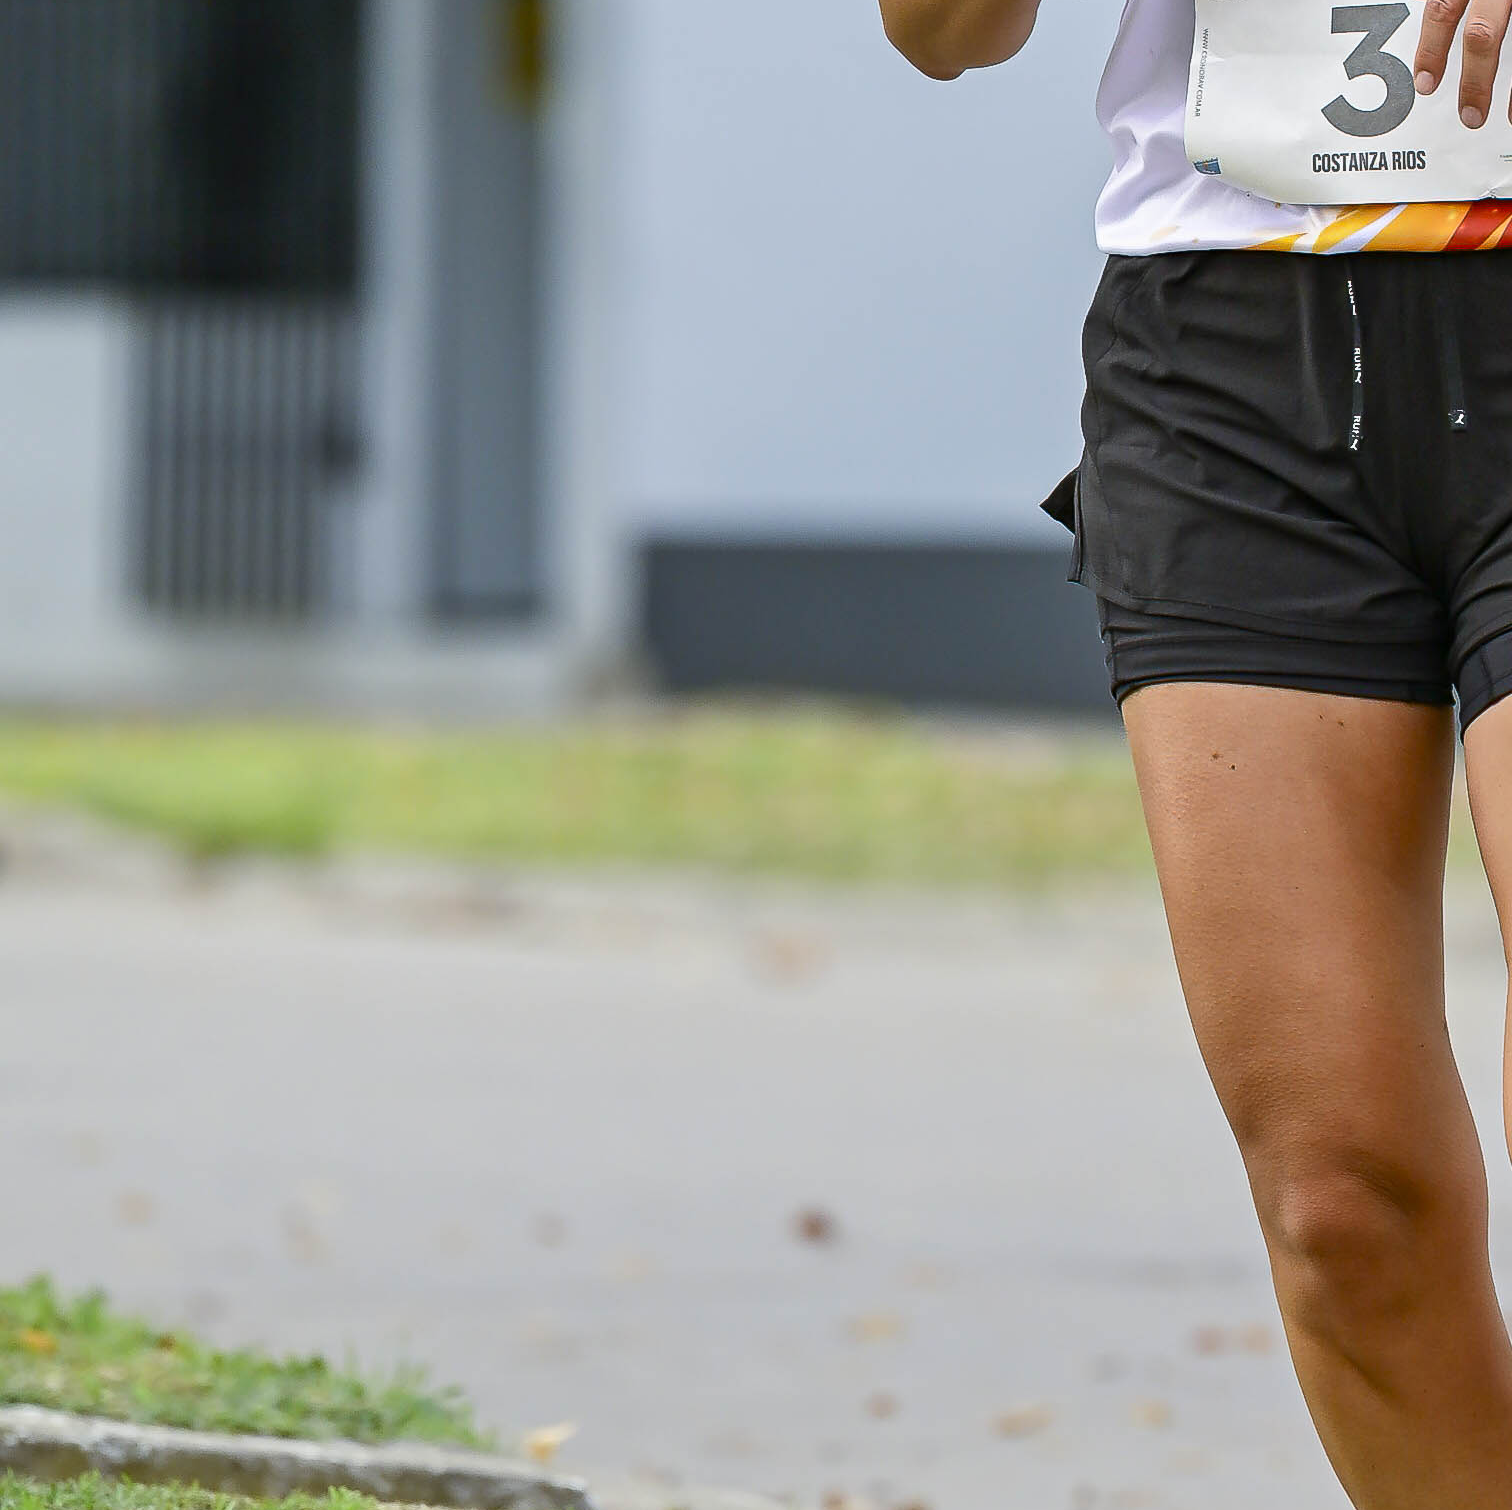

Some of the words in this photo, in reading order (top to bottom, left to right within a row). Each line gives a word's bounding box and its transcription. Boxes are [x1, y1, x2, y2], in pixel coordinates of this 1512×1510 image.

[1321, 2, 1416, 138] 3
[1312, 152, 1389, 173] COSTANZA
[1392, 150, 1427, 171] RIOS
